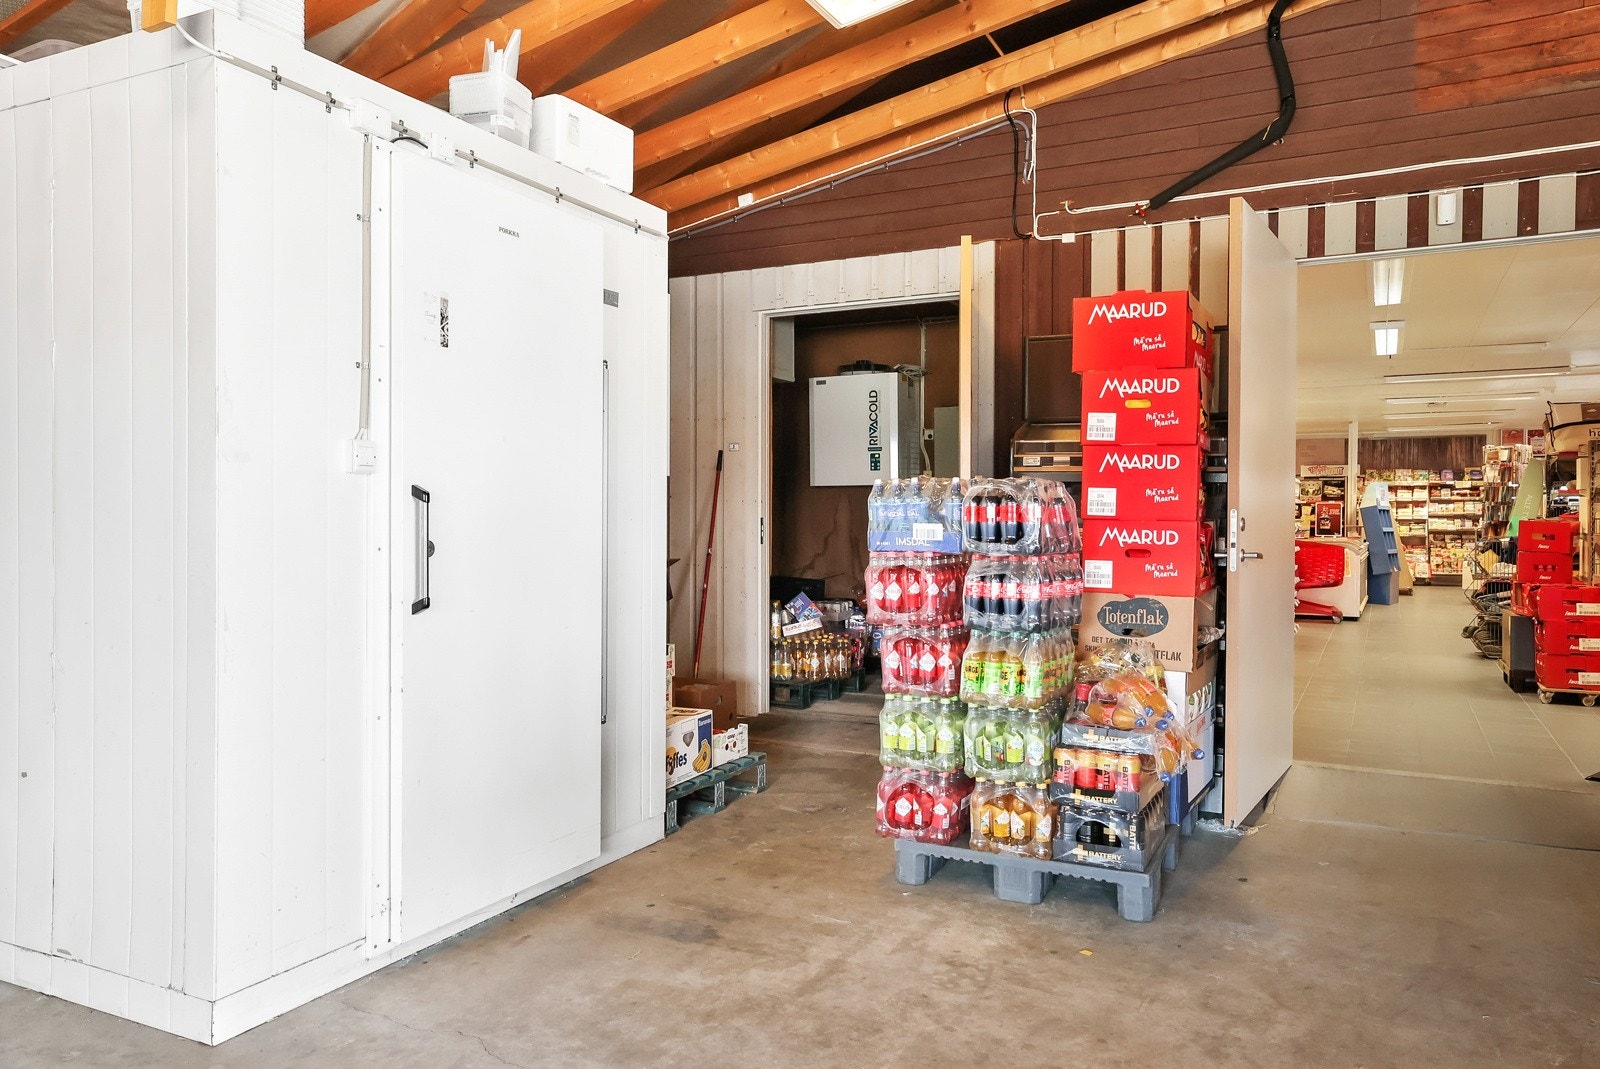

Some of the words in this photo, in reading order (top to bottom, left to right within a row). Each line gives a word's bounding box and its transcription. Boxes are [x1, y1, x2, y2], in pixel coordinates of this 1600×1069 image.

[498, 226, 520, 238] PORKKA
[1088, 302, 1167, 325] MAARUD
[1142, 341, 1166, 351] Maarud
[1099, 378, 1180, 398] MAARUD
[869, 389, 878, 446] RIVACOLD
[1154, 418, 1179, 428] Maarud
[1099, 452, 1180, 473] MAARUD
[1154, 494, 1179, 504] Maarud
[1099, 526, 1179, 547] MAARUD
[1153, 570, 1178, 579] Maarud
[1103, 606, 1164, 626] Totenflak
[1085, 796, 1118, 805] BATTERY
[1088, 850, 1122, 861] BATTERY
